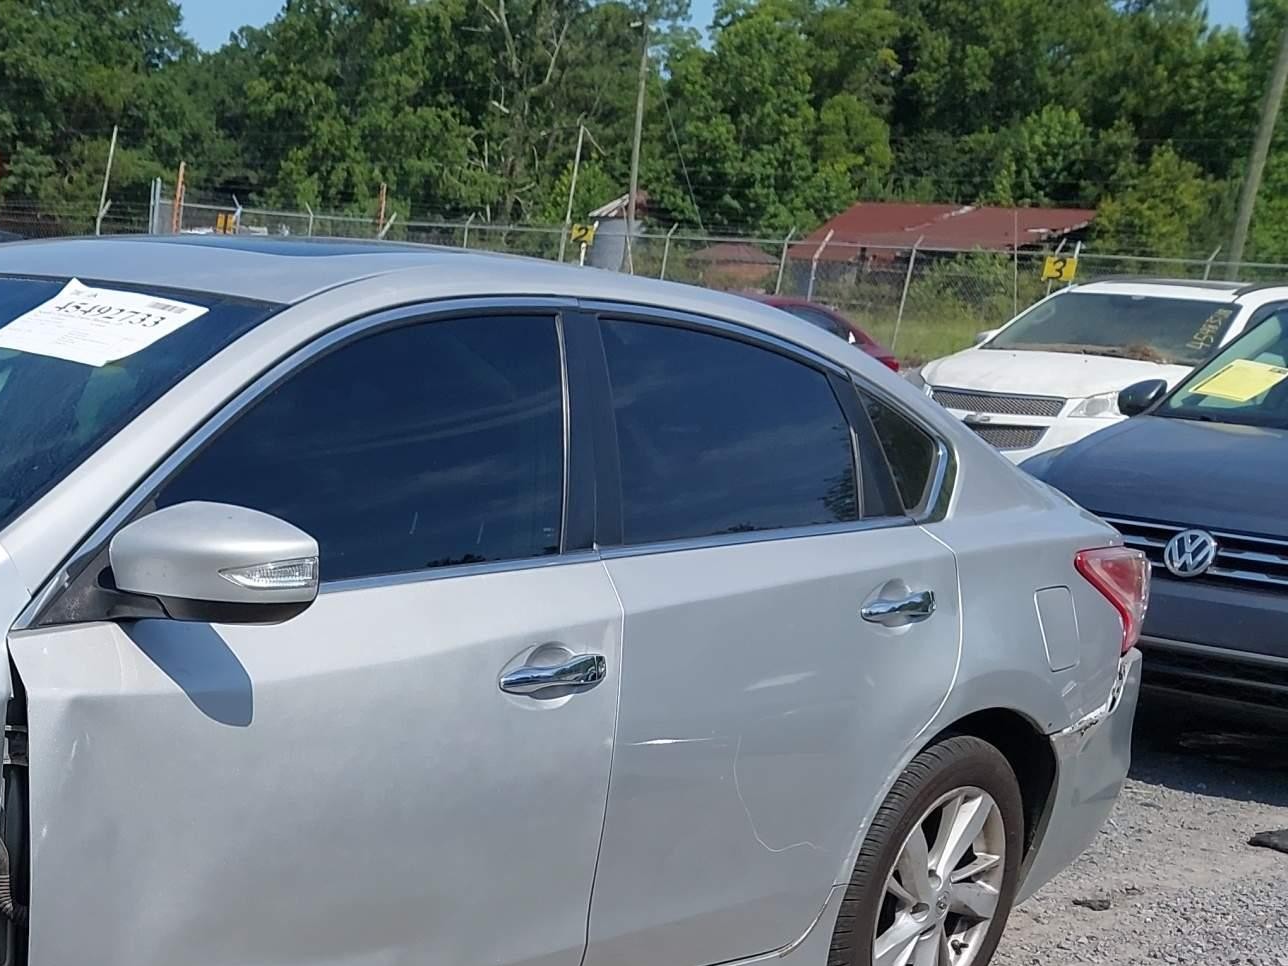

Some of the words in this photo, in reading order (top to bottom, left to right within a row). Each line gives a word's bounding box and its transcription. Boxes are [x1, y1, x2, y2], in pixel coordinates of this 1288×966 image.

[572, 227, 589, 241] 2
[1047, 259, 1067, 279] 3
[55, 300, 167, 328] 45492733
